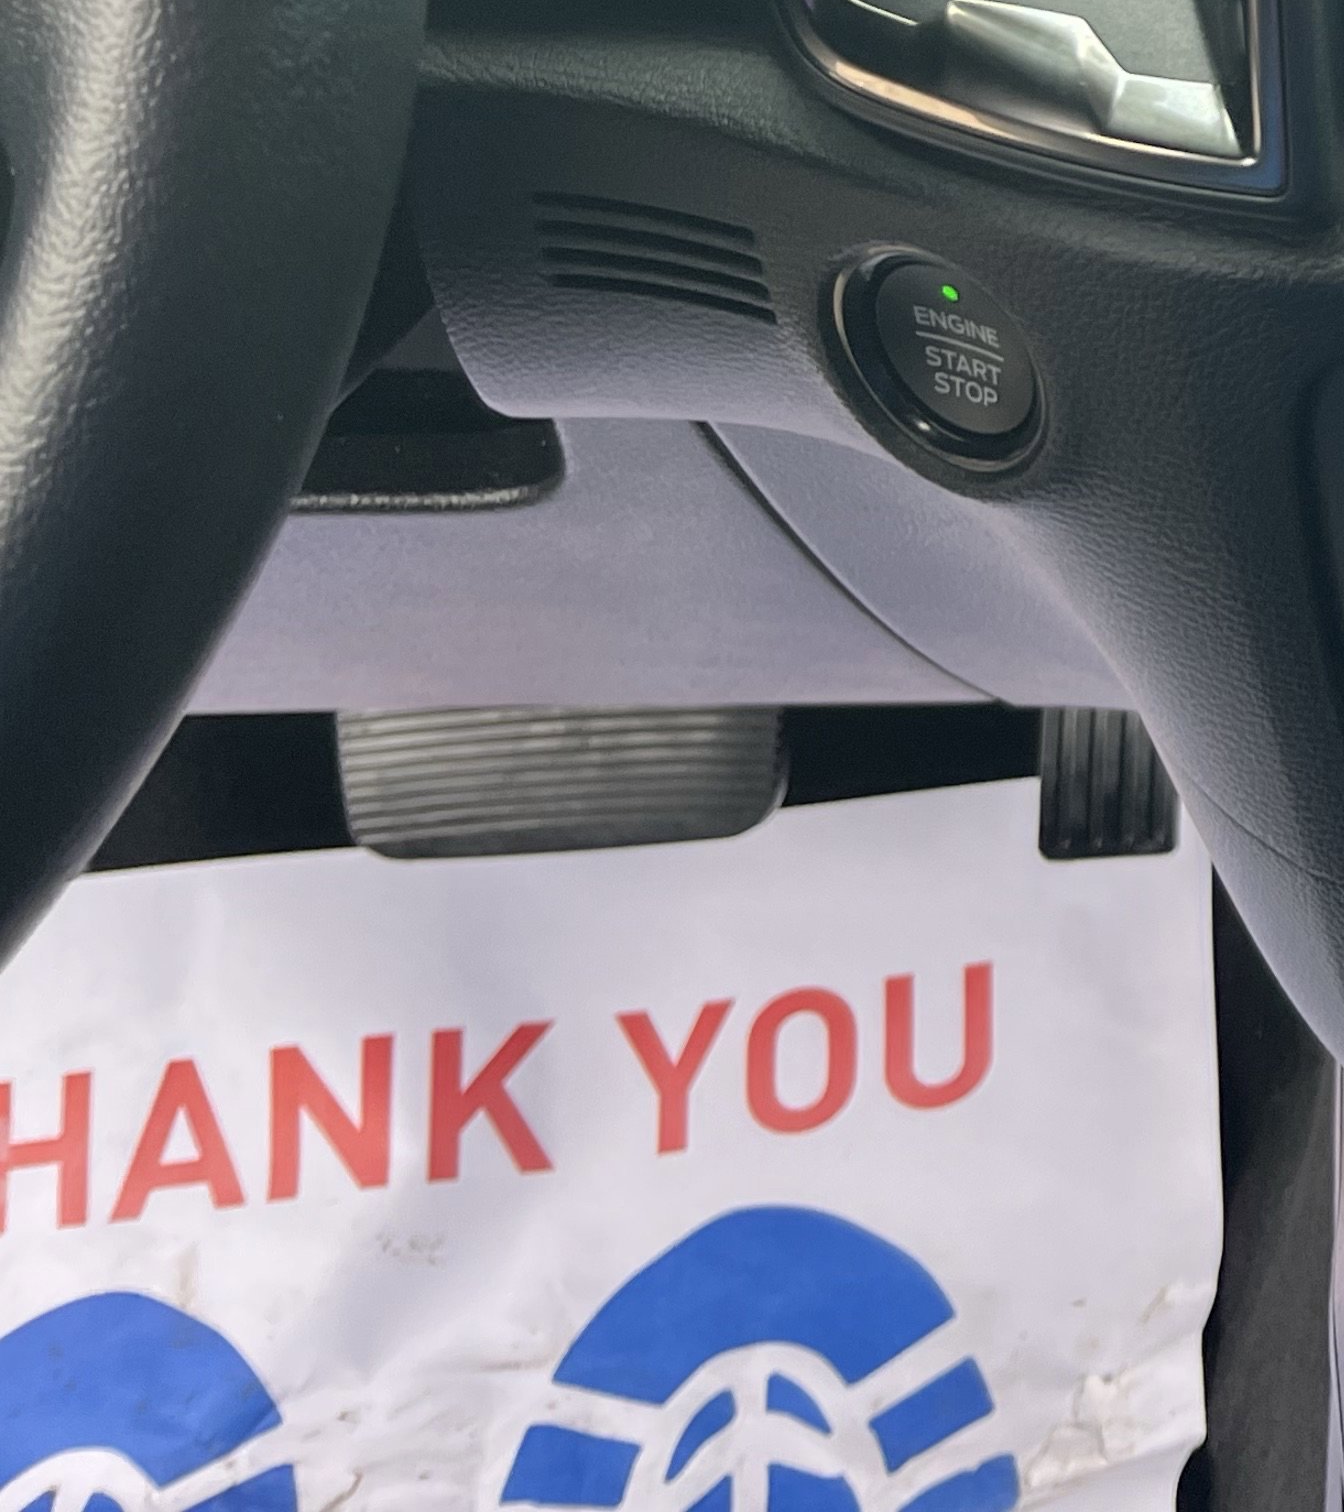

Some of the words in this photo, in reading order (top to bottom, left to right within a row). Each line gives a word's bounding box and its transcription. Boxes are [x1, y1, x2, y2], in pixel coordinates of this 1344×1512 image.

[912, 304, 1001, 349] ENGINE
[925, 345, 1003, 386] START
[933, 371, 999, 407] STOP
[614, 961, 995, 1159] YOU
